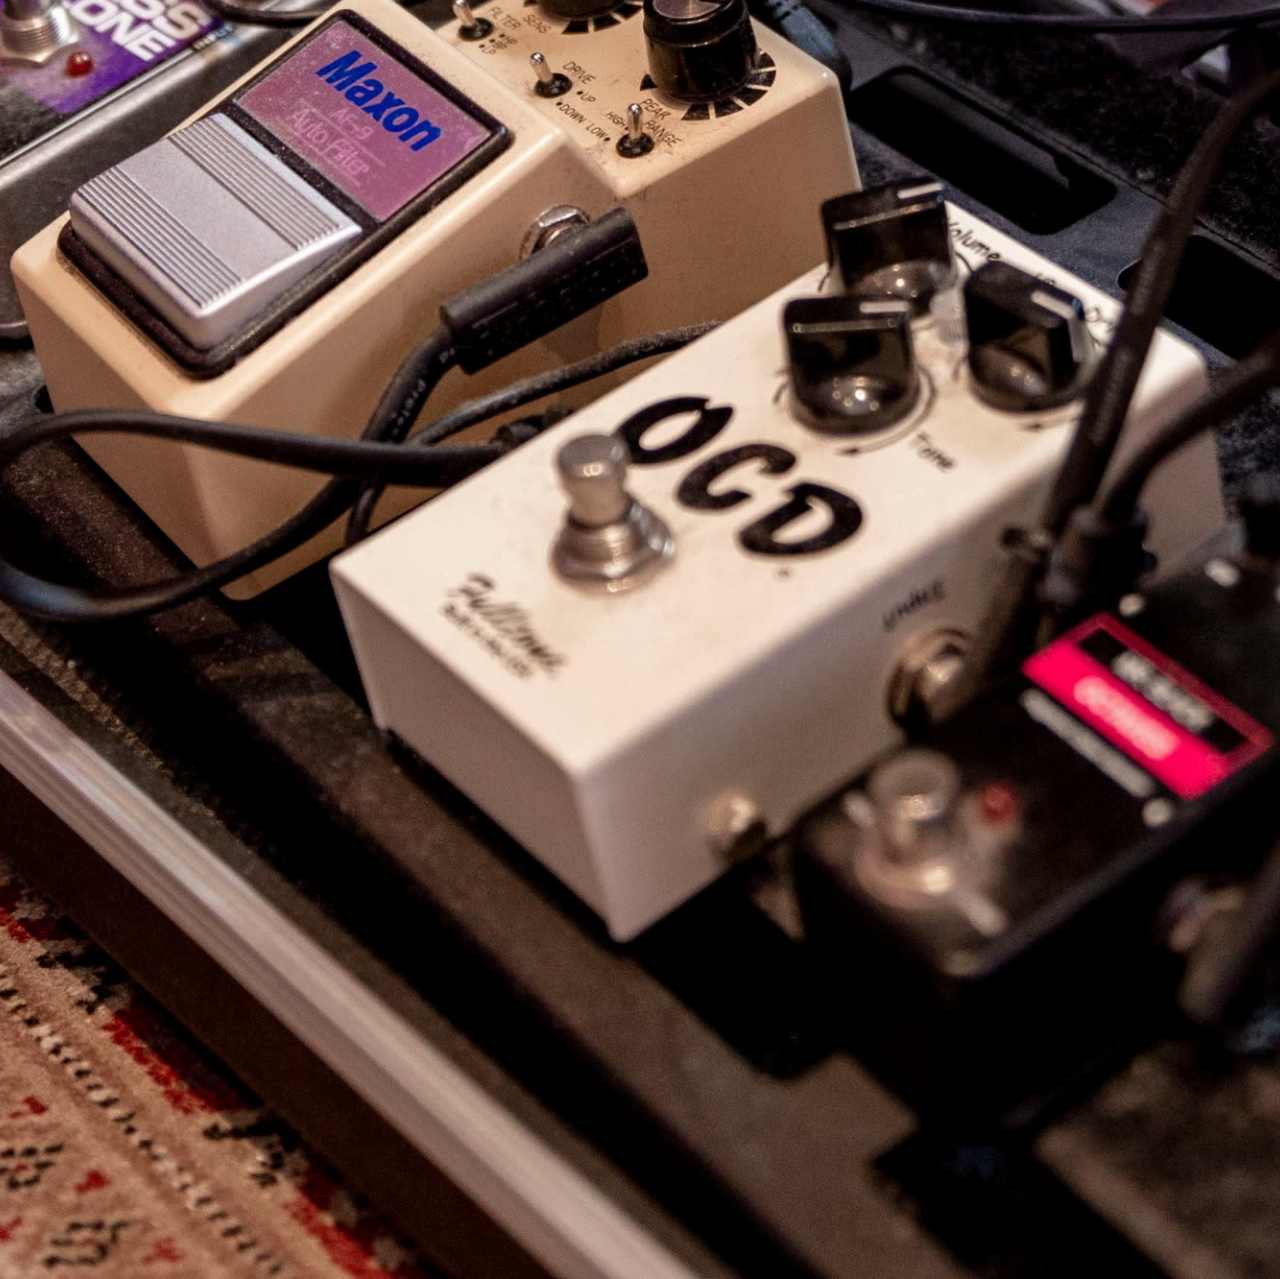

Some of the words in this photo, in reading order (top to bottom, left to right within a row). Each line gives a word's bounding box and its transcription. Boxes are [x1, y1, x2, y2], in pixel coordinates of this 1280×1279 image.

[562, 61, 596, 85] DRIVE
[315, 49, 442, 152] Maxon
[580, 90, 597, 103] UP
[559, 104, 587, 124] DOWN
[283, 108, 328, 145] Auto
[586, 122, 609, 139] LOW
[613, 396, 863, 558] OCD
